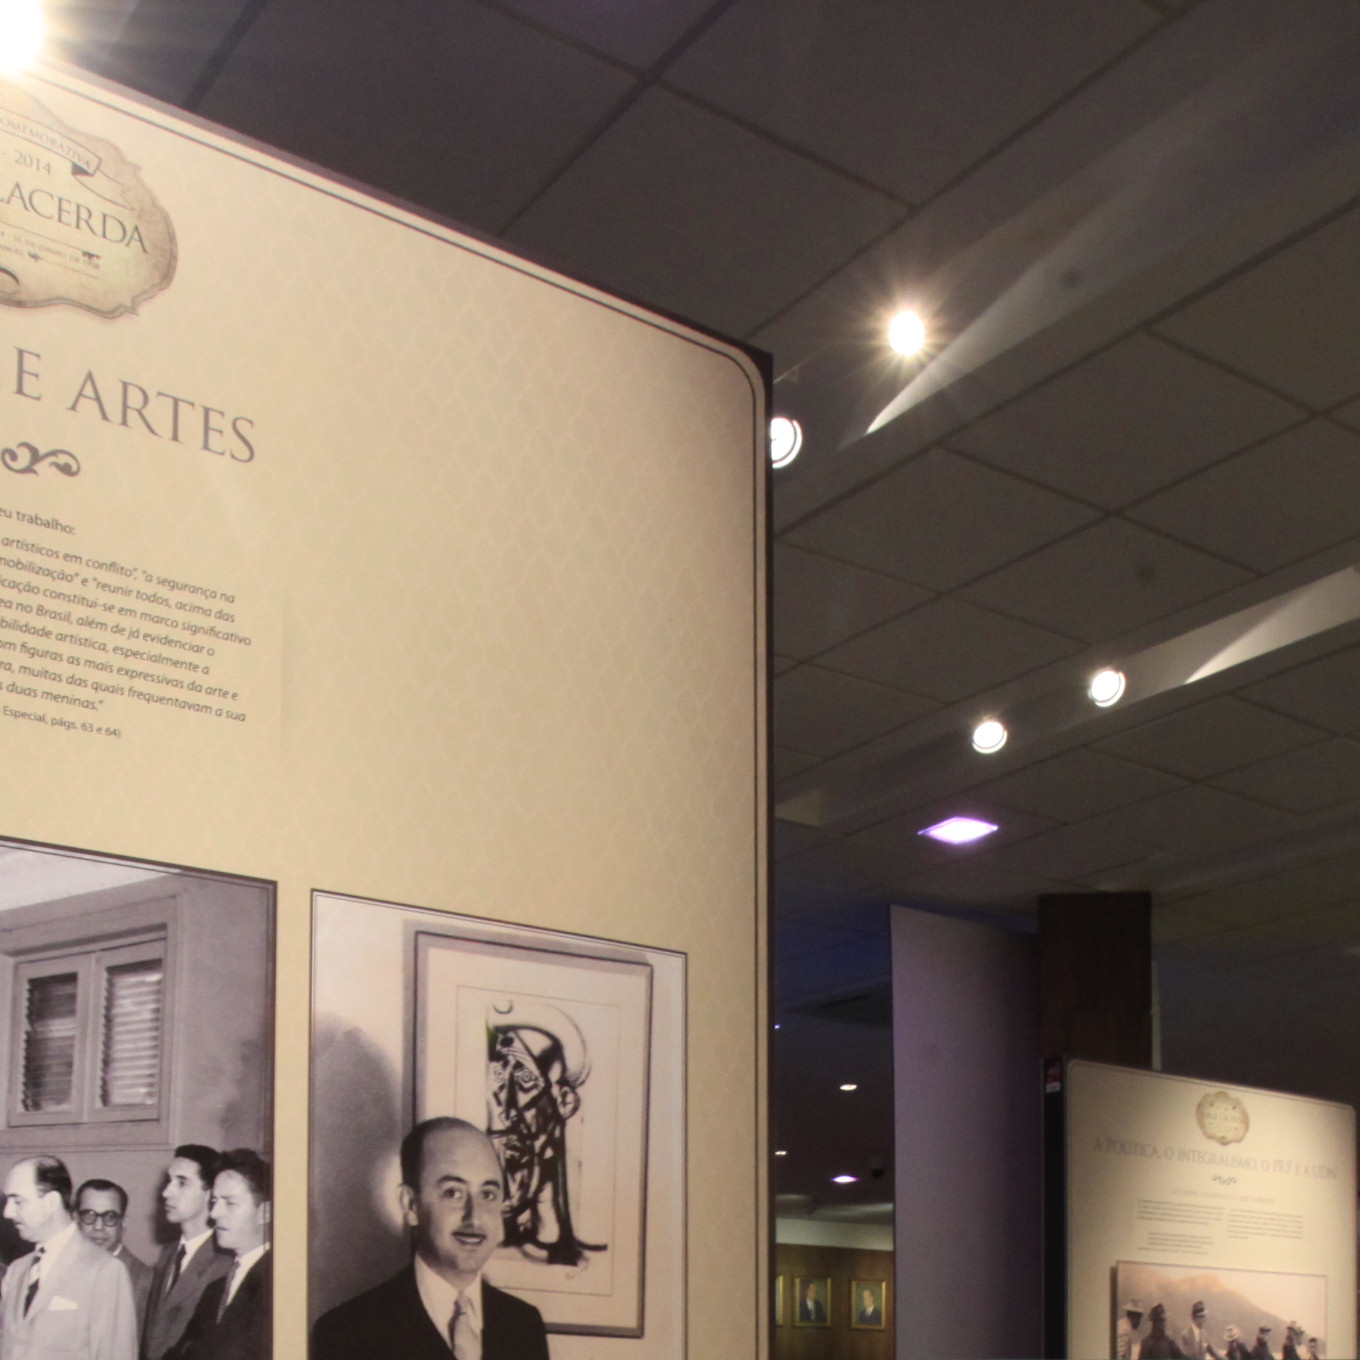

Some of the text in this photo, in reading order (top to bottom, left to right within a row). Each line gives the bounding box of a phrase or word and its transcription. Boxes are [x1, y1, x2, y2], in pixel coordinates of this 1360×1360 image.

[14, 151, 51, 175] 2014
[13, 347, 42, 401] E
[66, 370, 256, 464] ARTES
[16, 509, 76, 535] trabalho:
[1, 536, 59, 559] artísticos
[63, 552, 82, 565] em
[155, 575, 218, 600] segurança
[220, 591, 236, 604] na
[174, 600, 212, 618] acima
[214, 607, 235, 623] das
[15, 601, 32, 614] no
[76, 615, 108, 632] além
[110, 622, 126, 637] de
[126, 626, 140, 641] já
[142, 631, 204, 654] evidenciar
[19, 640, 64, 662] figuras
[66, 654, 81, 667] as
[84, 657, 114, 674] mais
[116, 665, 184, 690] expressivas
[186, 679, 202, 693] da
[204, 685, 228, 699] arte
[112, 644, 199, 673] especialmente
[6, 680, 38, 698] duas
